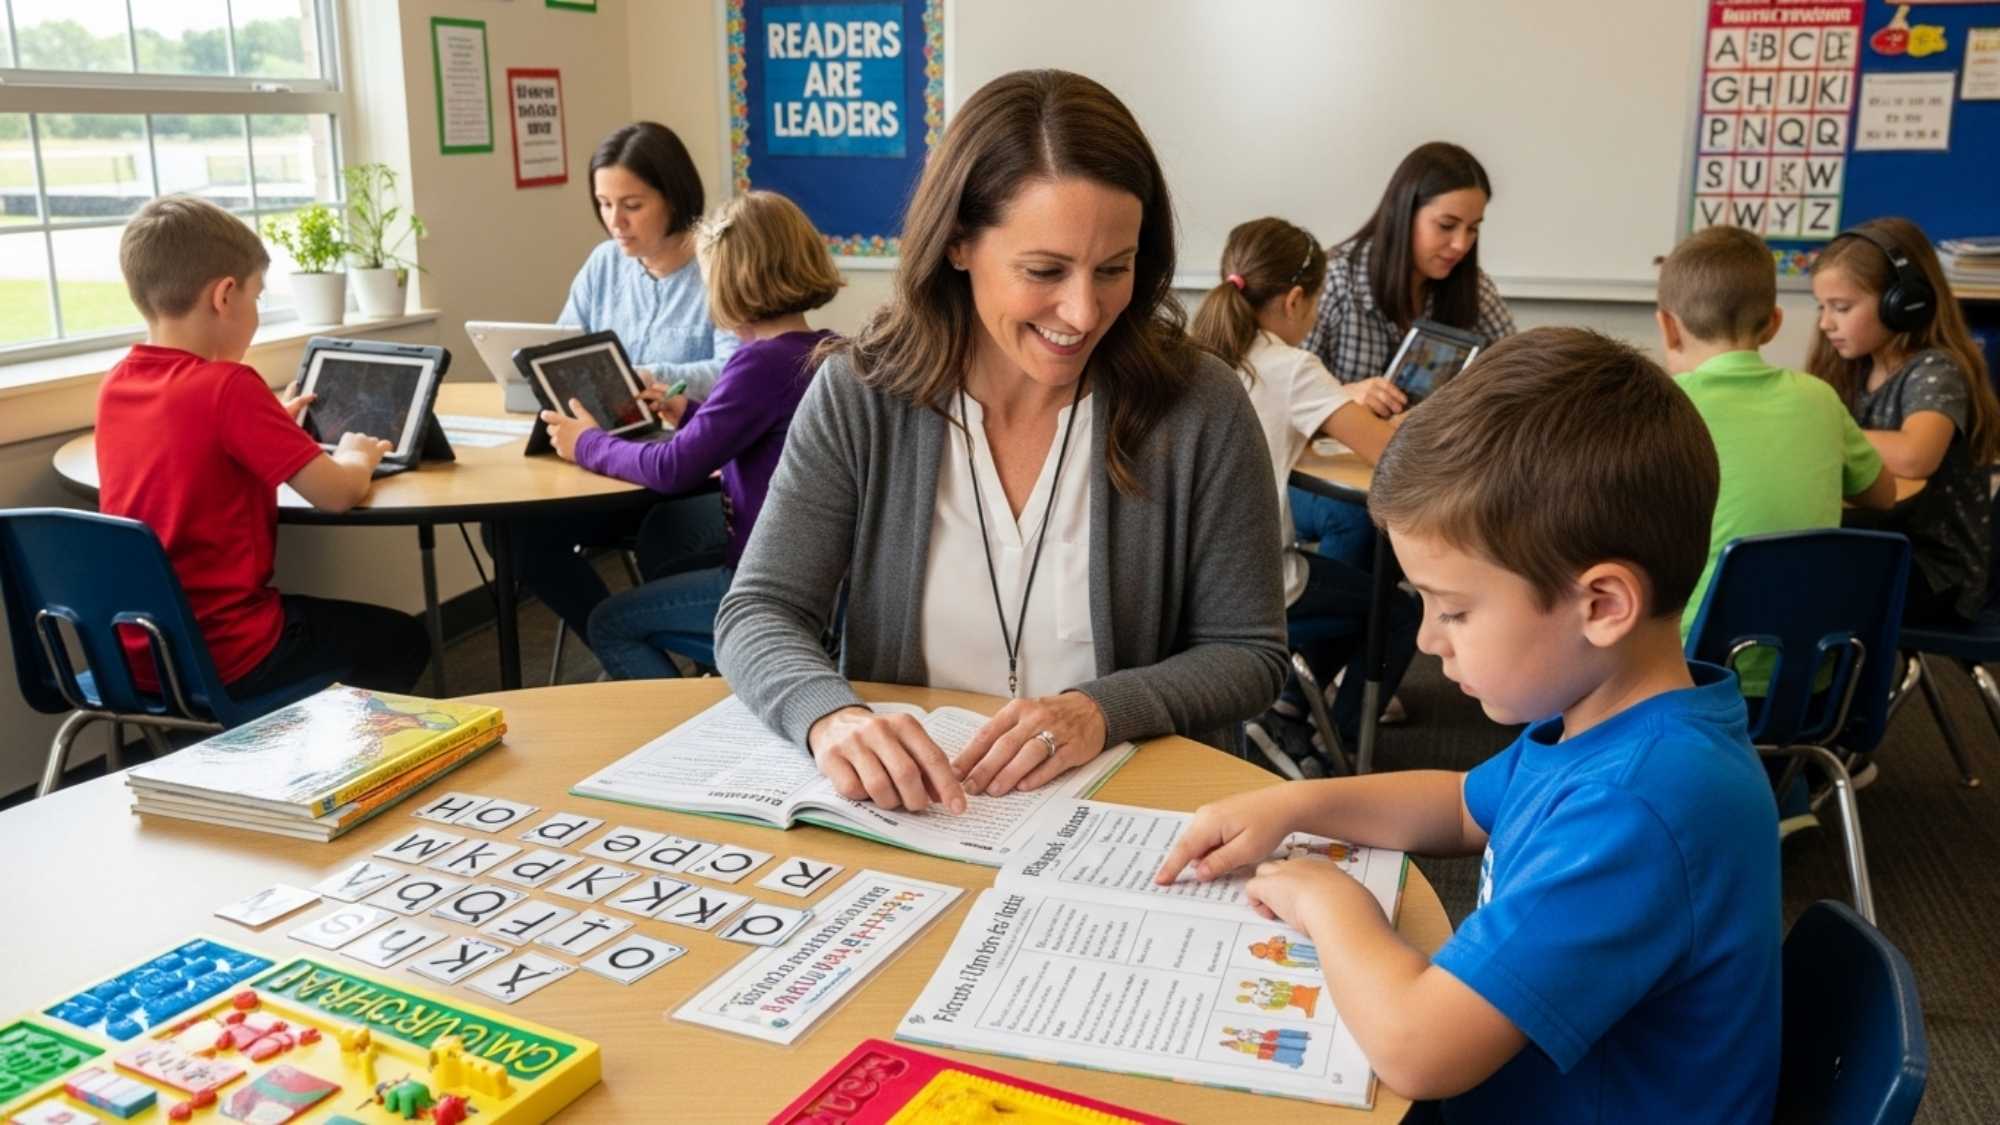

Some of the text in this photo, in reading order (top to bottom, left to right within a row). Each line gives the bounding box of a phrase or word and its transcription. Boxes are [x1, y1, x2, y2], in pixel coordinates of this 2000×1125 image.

[767, 21, 901, 58] READERS
[1715, 35, 1739, 62] A
[1789, 32, 1815, 61] C
[803, 61, 862, 98] ARE
[1711, 76, 1739, 103] G
[1748, 76, 1772, 104] H
[774, 101, 899, 137] LEADERS
[1709, 118, 1728, 146] P
[1741, 118, 1767, 145] N
[1778, 118, 1804, 147] Q
[1705, 161, 1723, 188] S
[1806, 161, 1838, 188] W
[1700, 202, 1831, 230] V W Y Z
